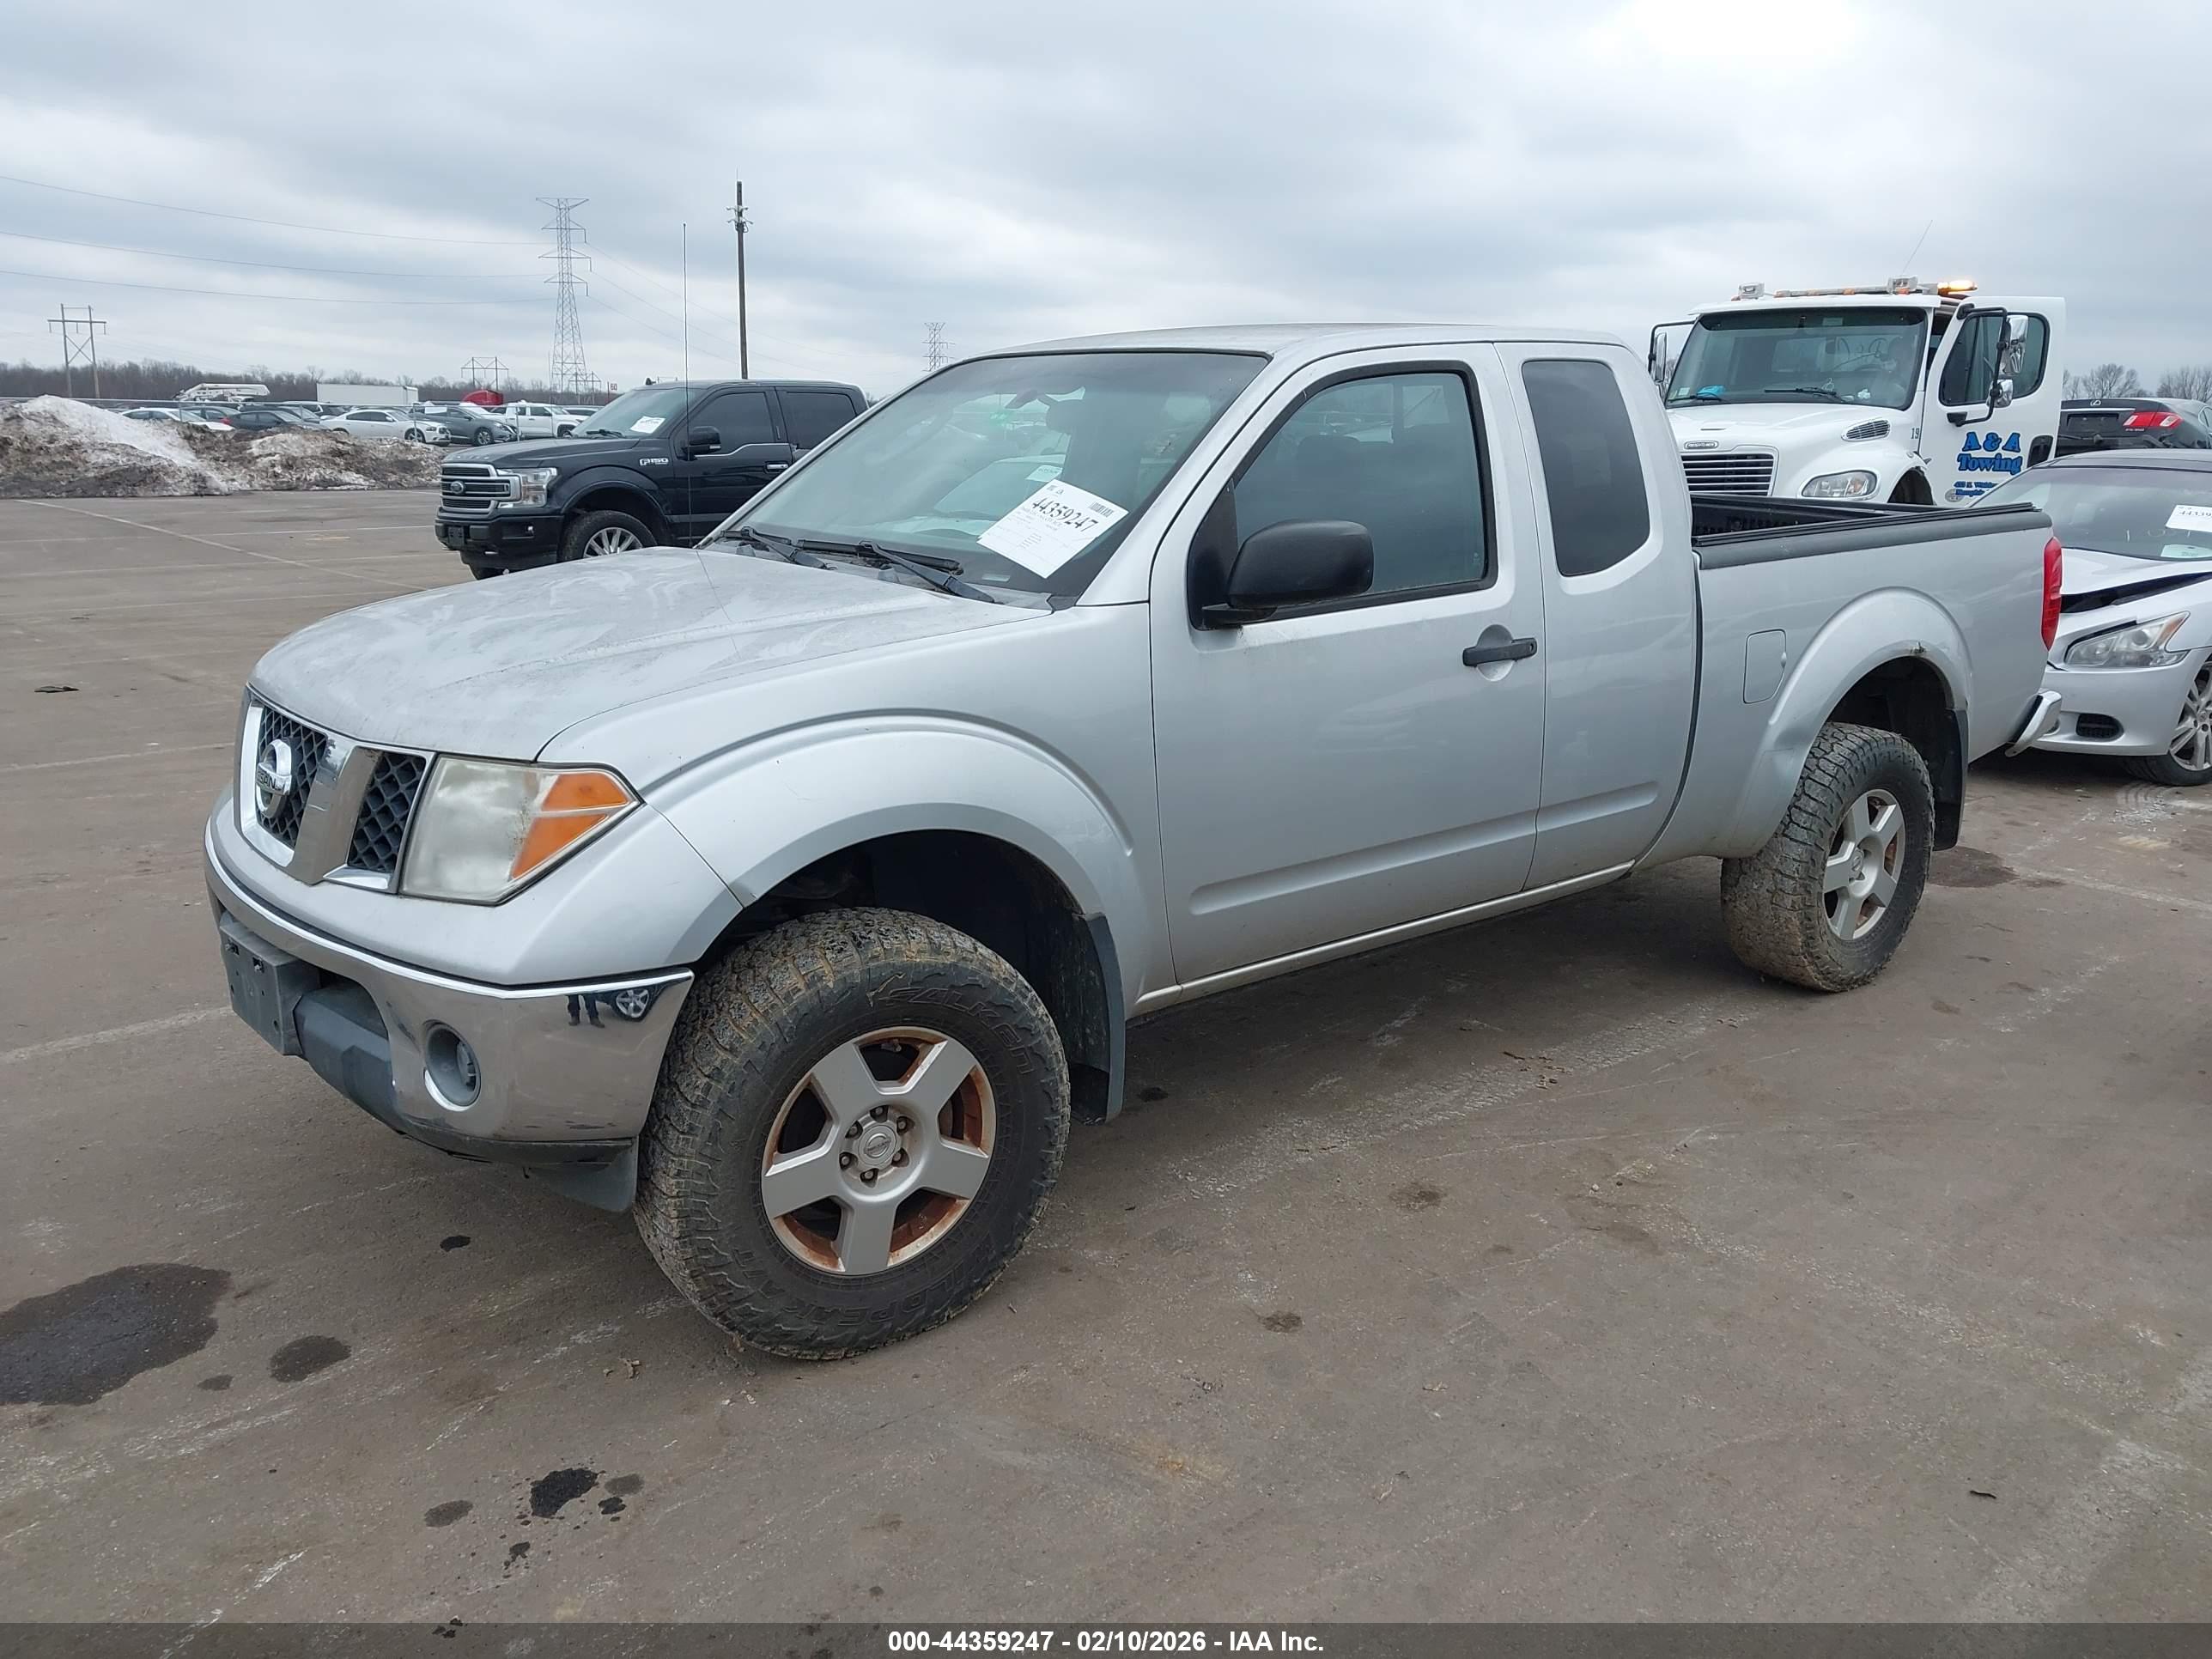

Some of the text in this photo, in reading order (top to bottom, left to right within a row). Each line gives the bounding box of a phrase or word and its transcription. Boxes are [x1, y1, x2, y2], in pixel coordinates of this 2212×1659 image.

[1911, 428, 1920, 439] 19
[1957, 453, 2023, 476] Towing
[1032, 497, 1098, 532] 44359247
